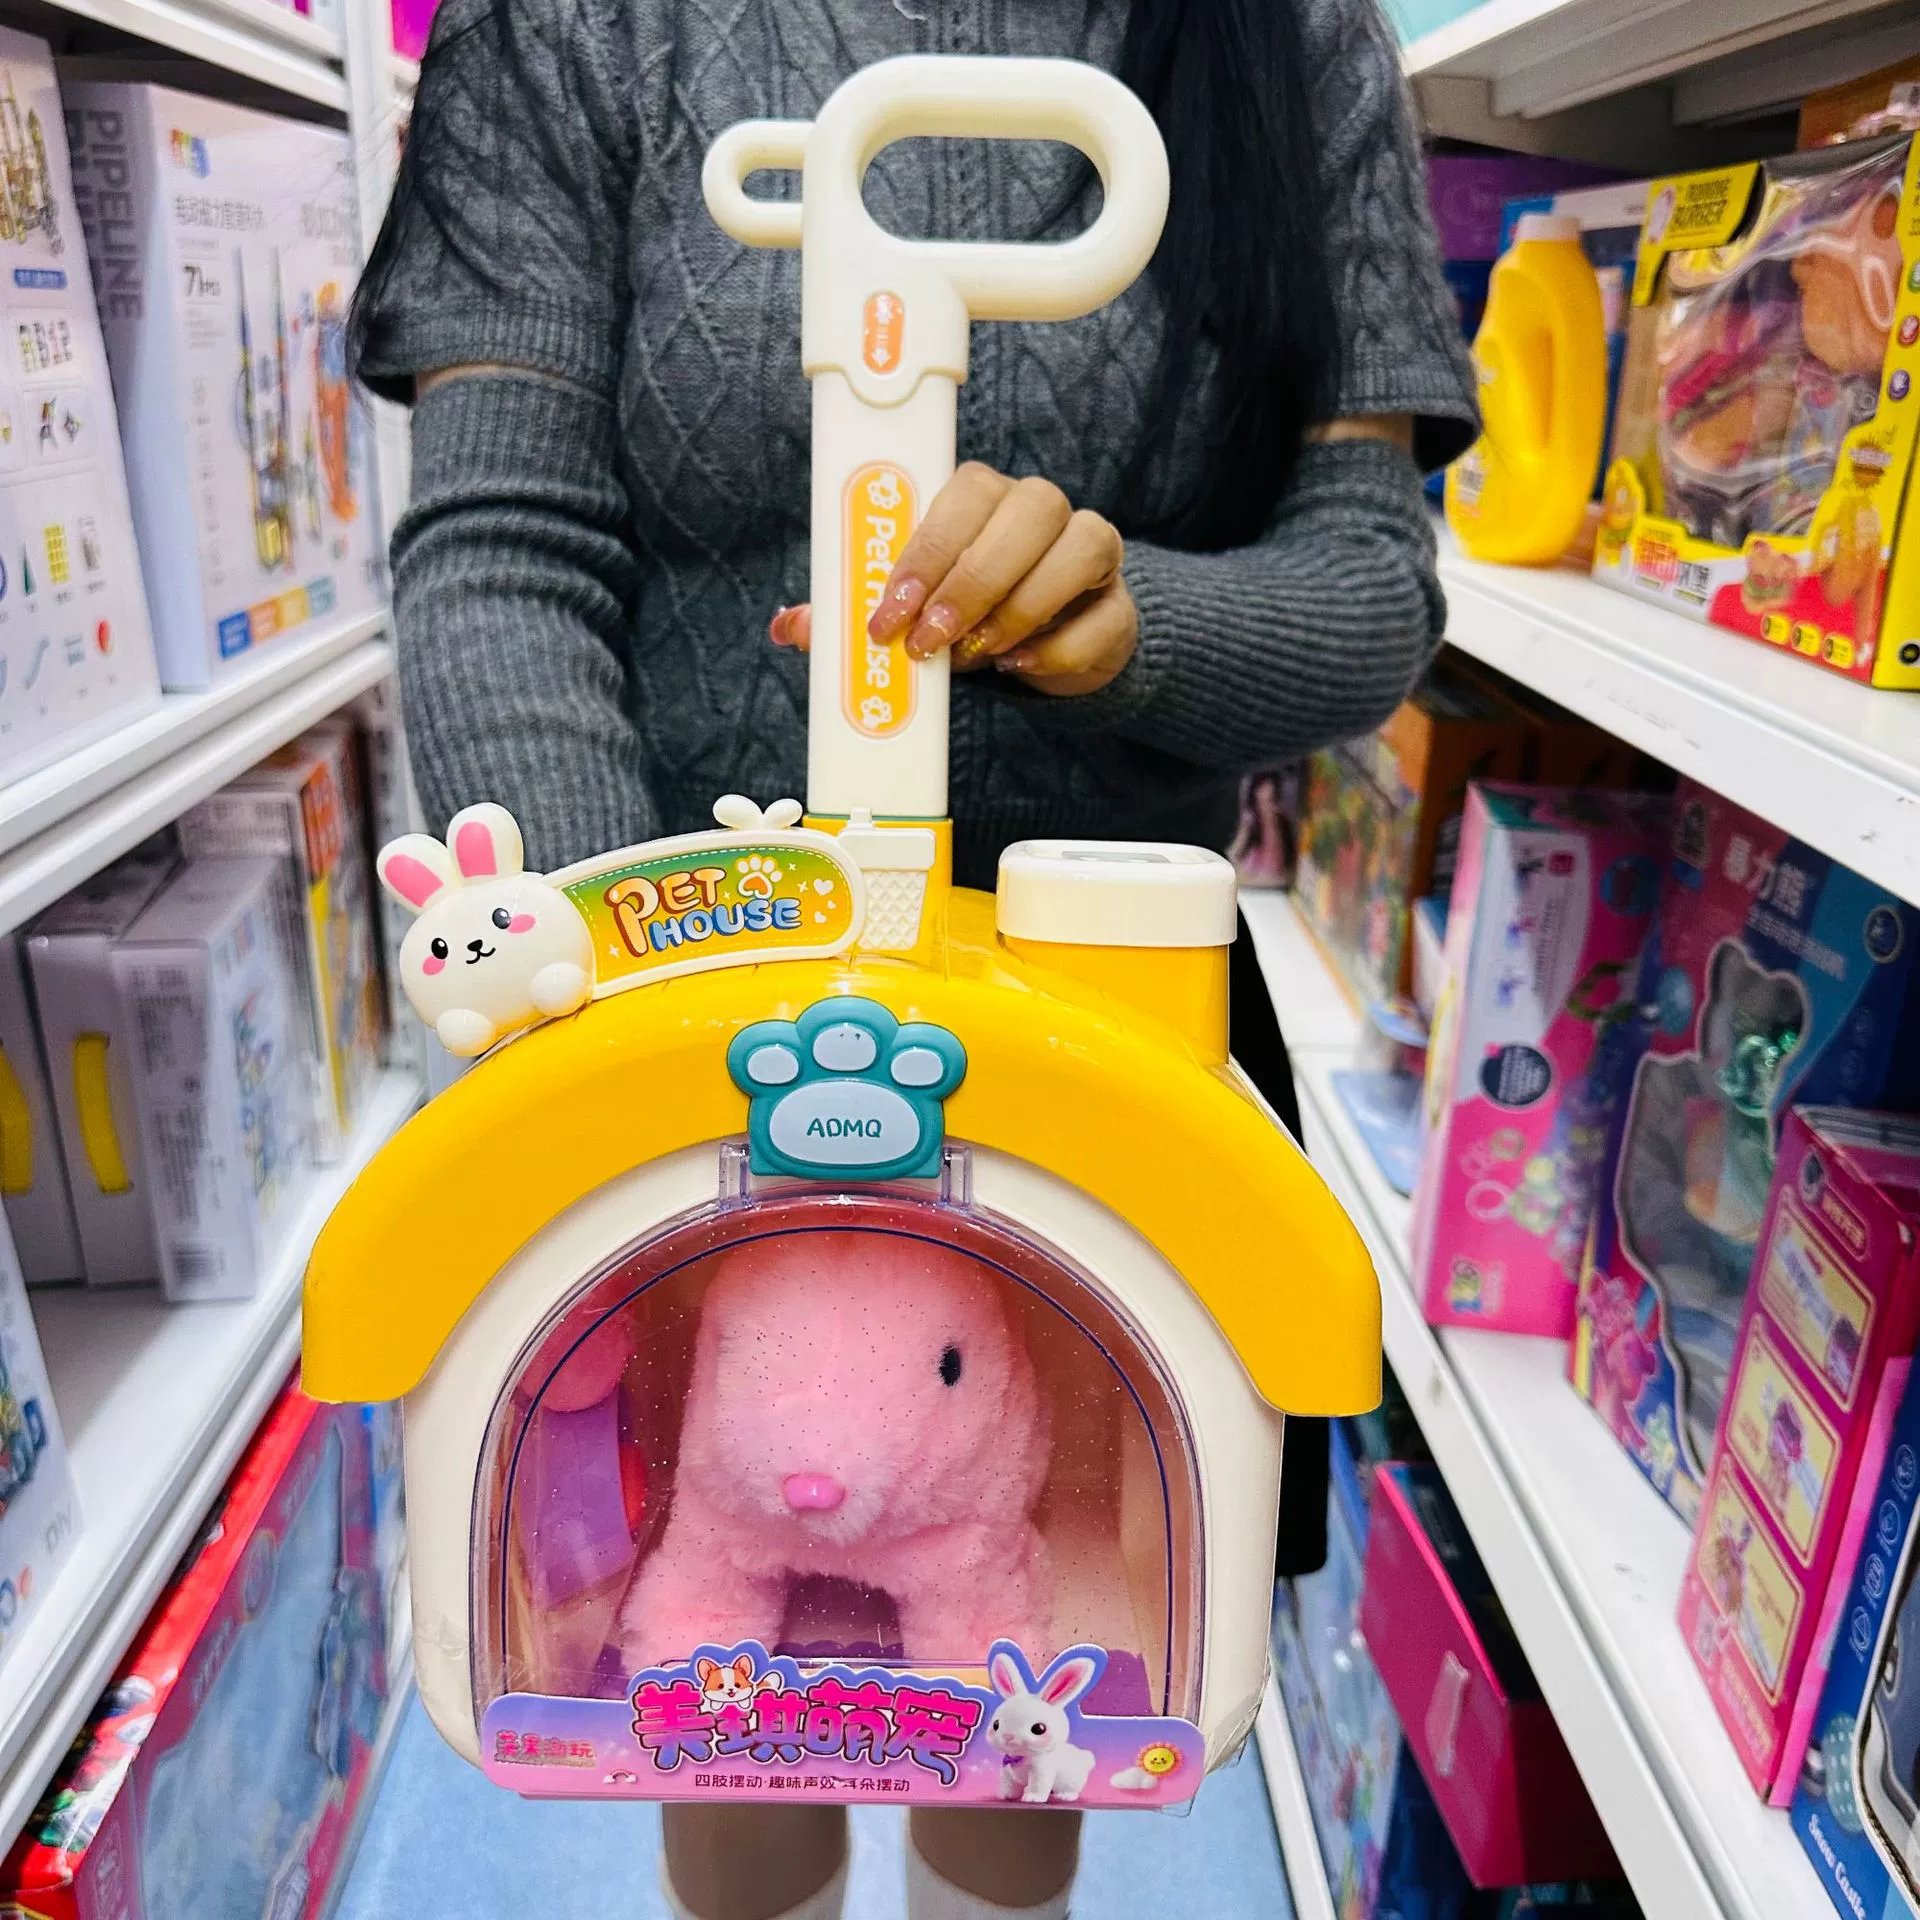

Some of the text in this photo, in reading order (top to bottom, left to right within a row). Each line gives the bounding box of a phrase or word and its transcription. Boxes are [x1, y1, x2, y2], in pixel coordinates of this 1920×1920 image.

[86, 109, 143, 320] PIPELINE
[866, 514, 897, 574] Pet
[603, 867, 727, 957] PET
[648, 897, 802, 950] HOUSE
[632, 1678, 985, 1785] 美琪萌宠
